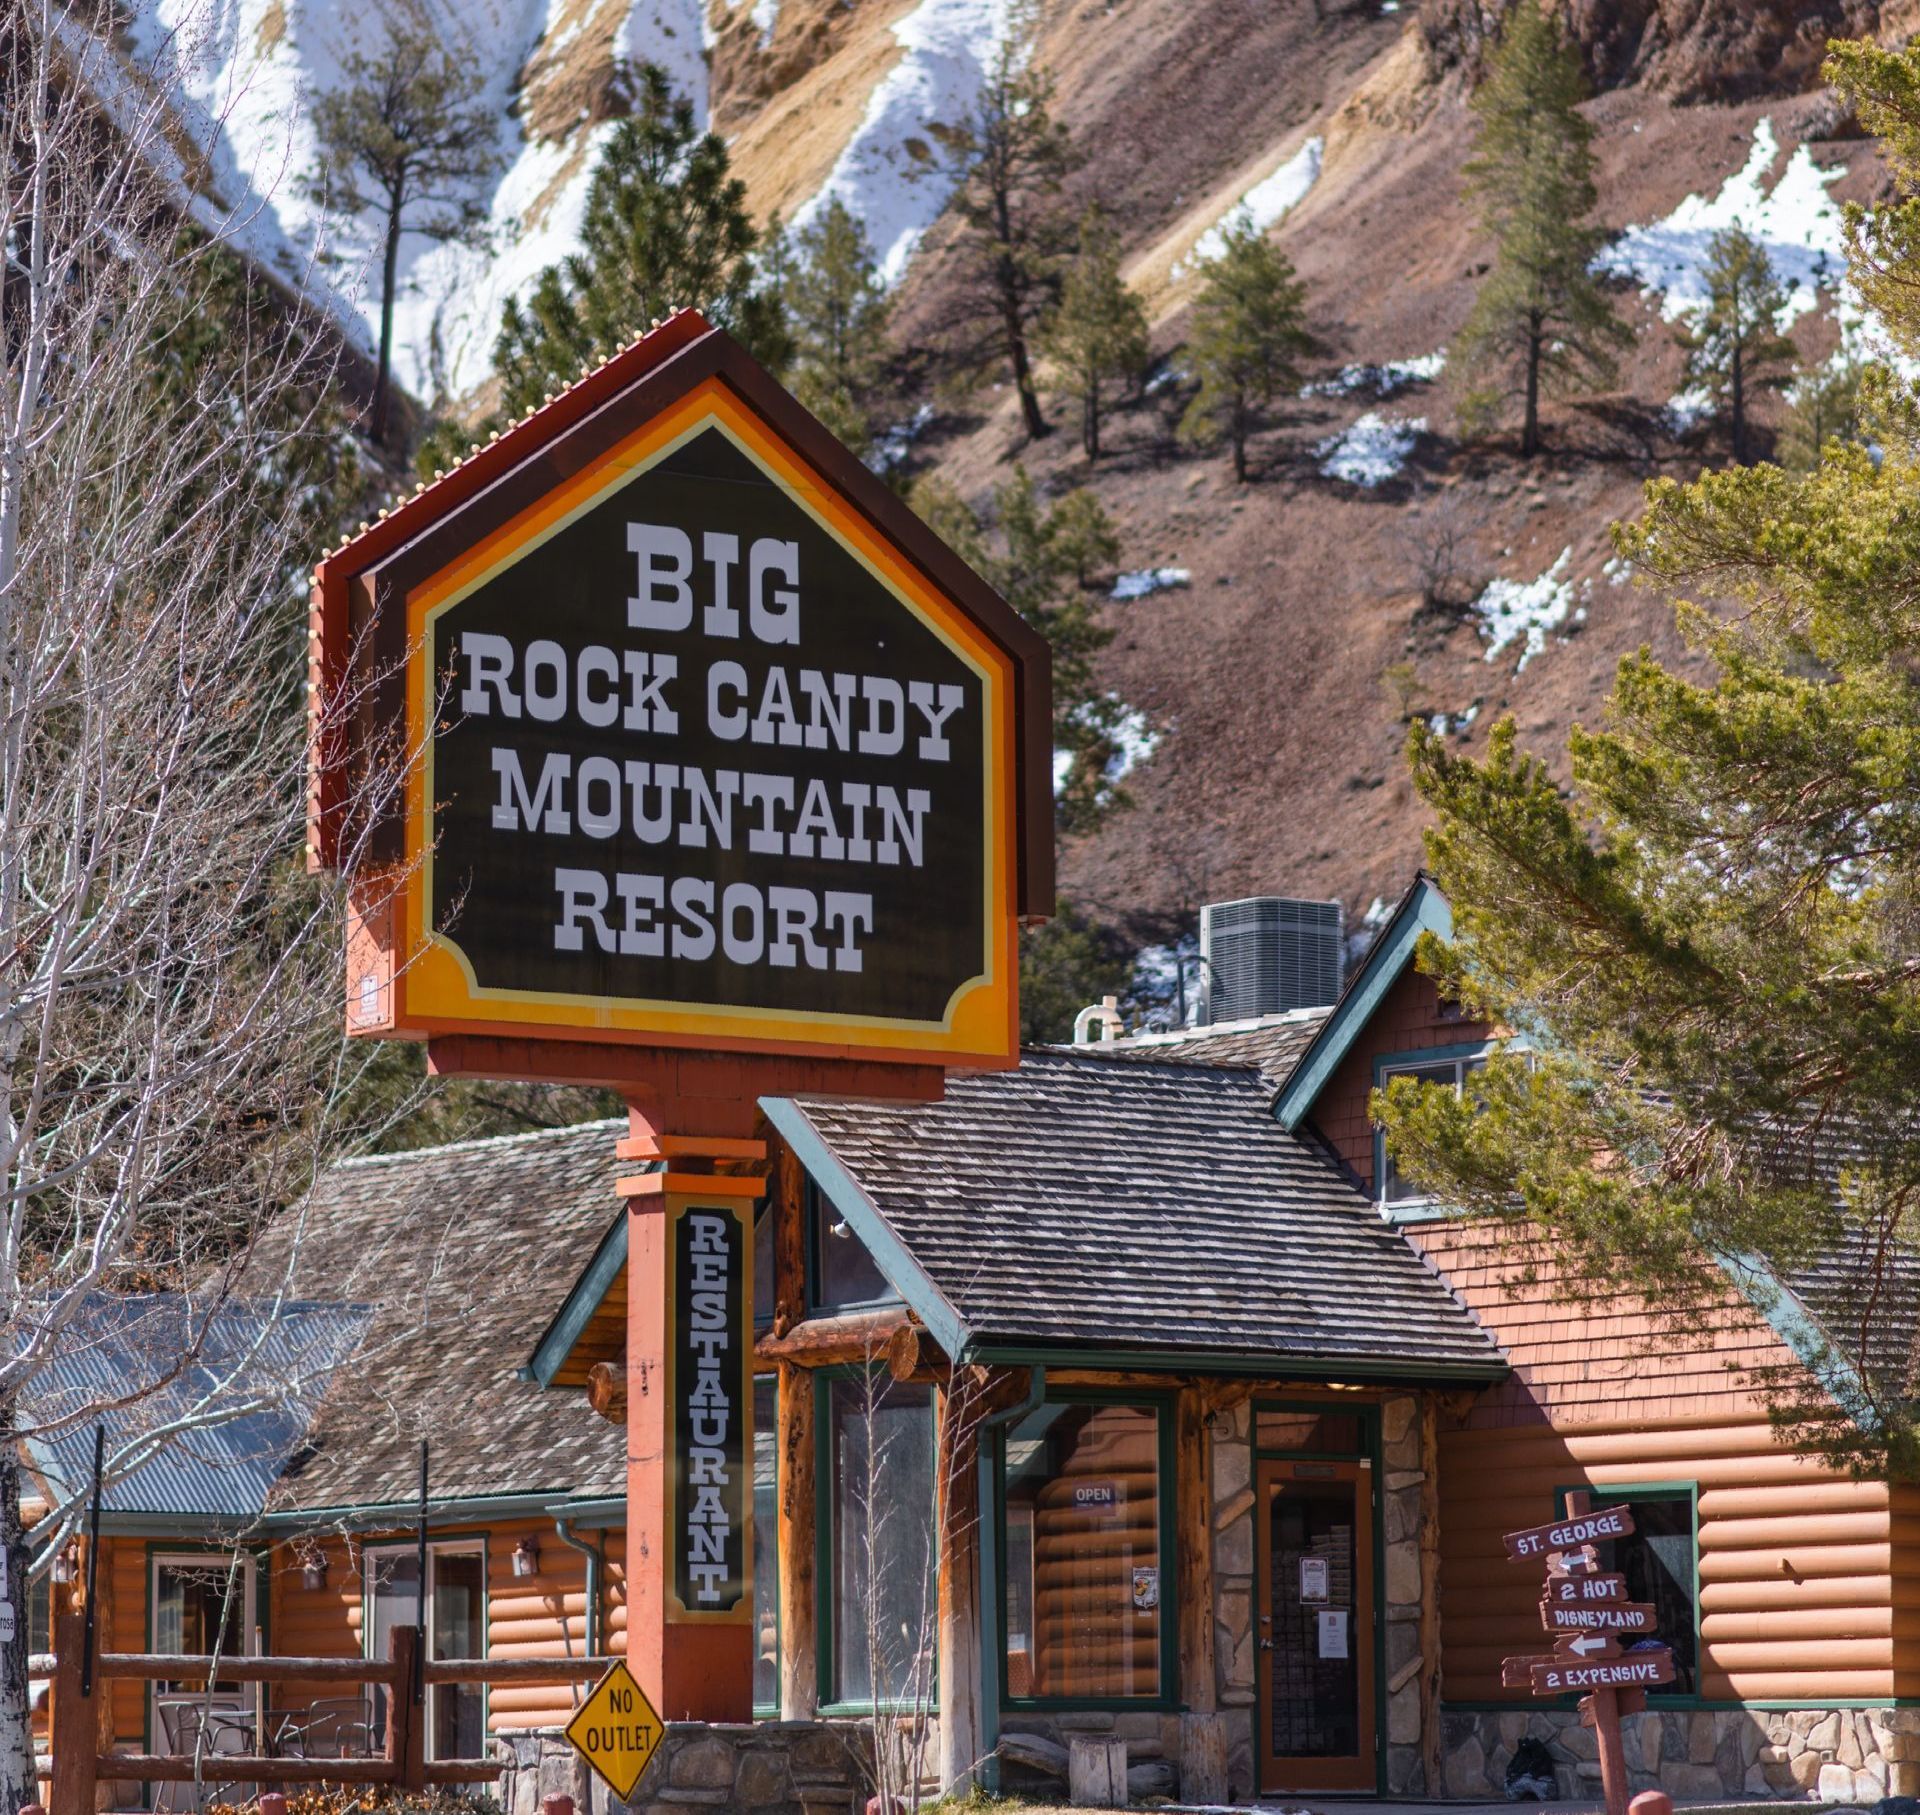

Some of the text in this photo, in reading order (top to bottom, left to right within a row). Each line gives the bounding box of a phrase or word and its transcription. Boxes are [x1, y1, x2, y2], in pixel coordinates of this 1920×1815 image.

[627, 522, 799, 644] BIG
[462, 631, 964, 761] ROCK CANDY
[492, 747, 931, 867] MOUNTAIN
[554, 867, 873, 973] RESORT
[688, 1215, 729, 1601] RESTAURANT
[1076, 1488, 1110, 1501] OPEN
[1518, 1515, 1623, 1555] ST. GEORGE
[1561, 1579, 1619, 1599] 2 HOT
[1554, 1610, 1645, 1628] DISNEYLAND
[1547, 1664, 1660, 1688] 2 EXPENSIVE
[610, 1689, 632, 1714] NO
[586, 1726, 652, 1753] OUTLET
